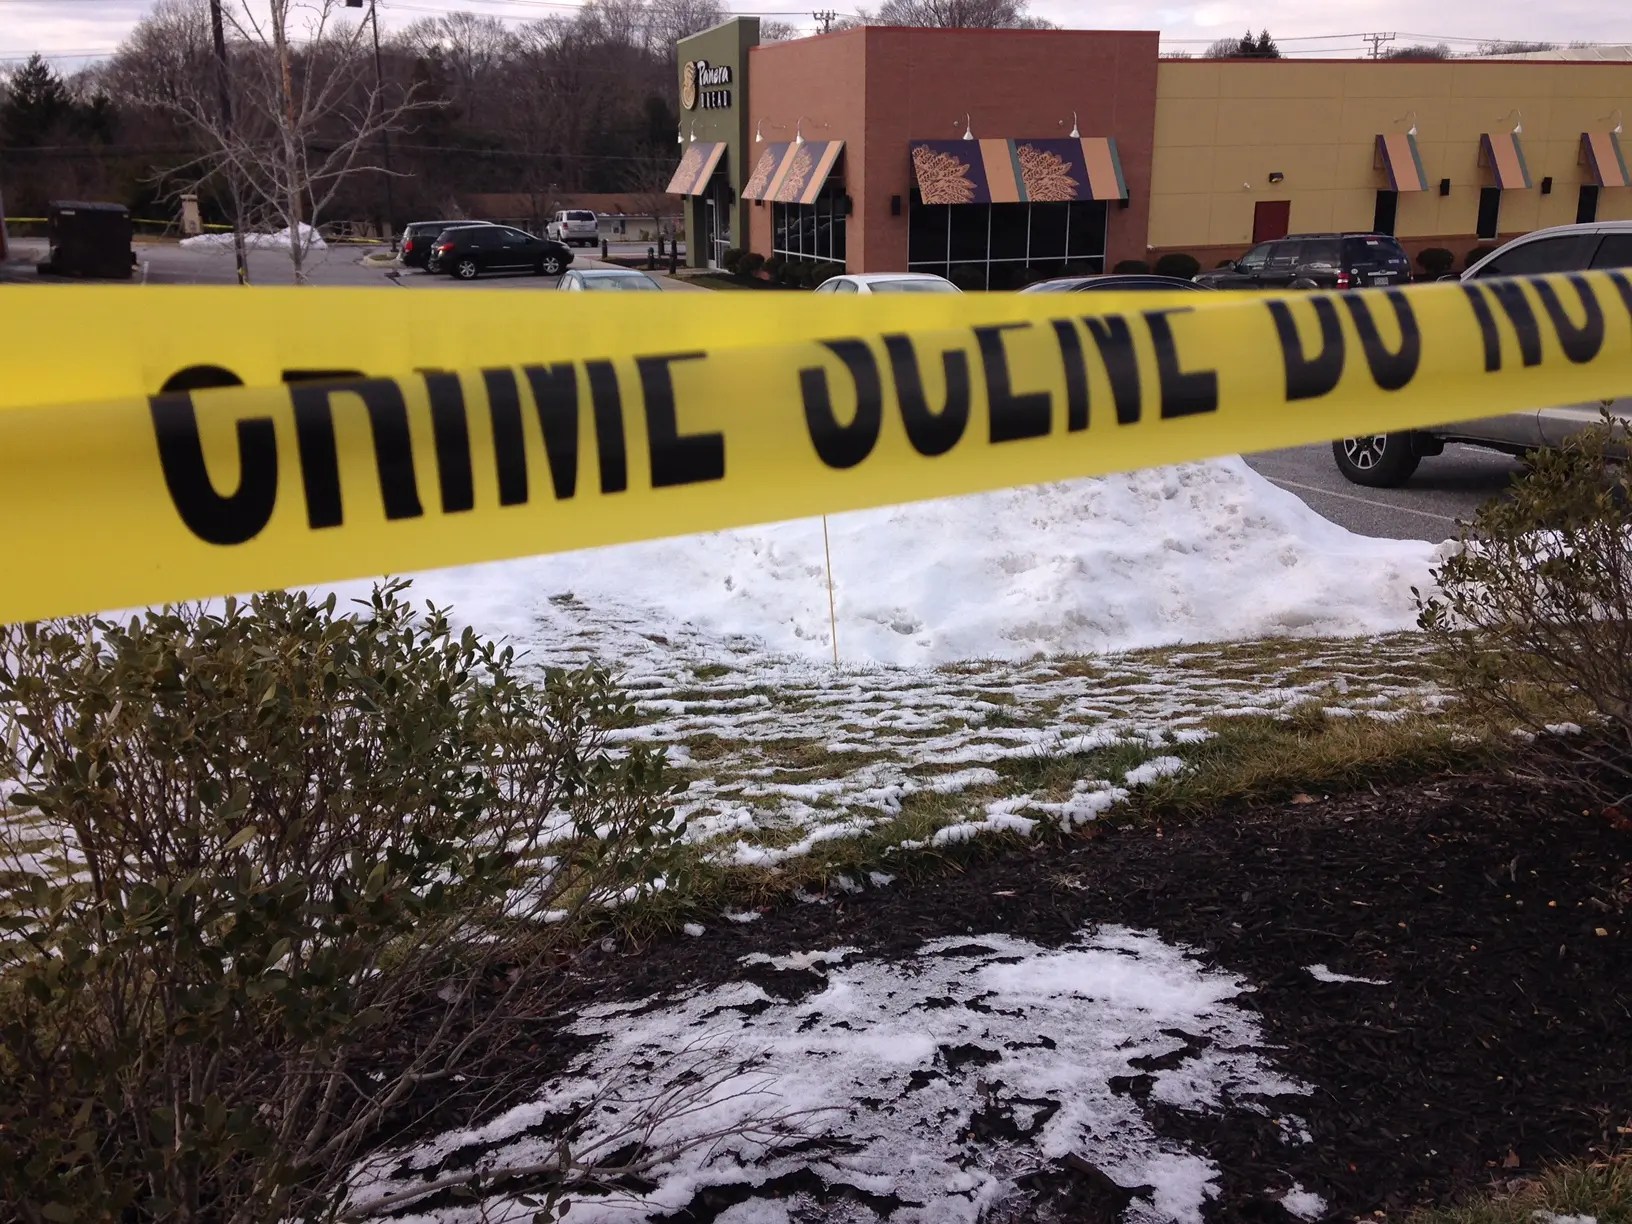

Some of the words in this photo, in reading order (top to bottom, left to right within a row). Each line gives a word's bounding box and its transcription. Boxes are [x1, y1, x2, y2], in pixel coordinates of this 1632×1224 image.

[697, 60, 730, 86] Panera
[147, 349, 726, 546] CRIME
[799, 306, 1219, 470] SCENE
[1266, 290, 1422, 402] DO
